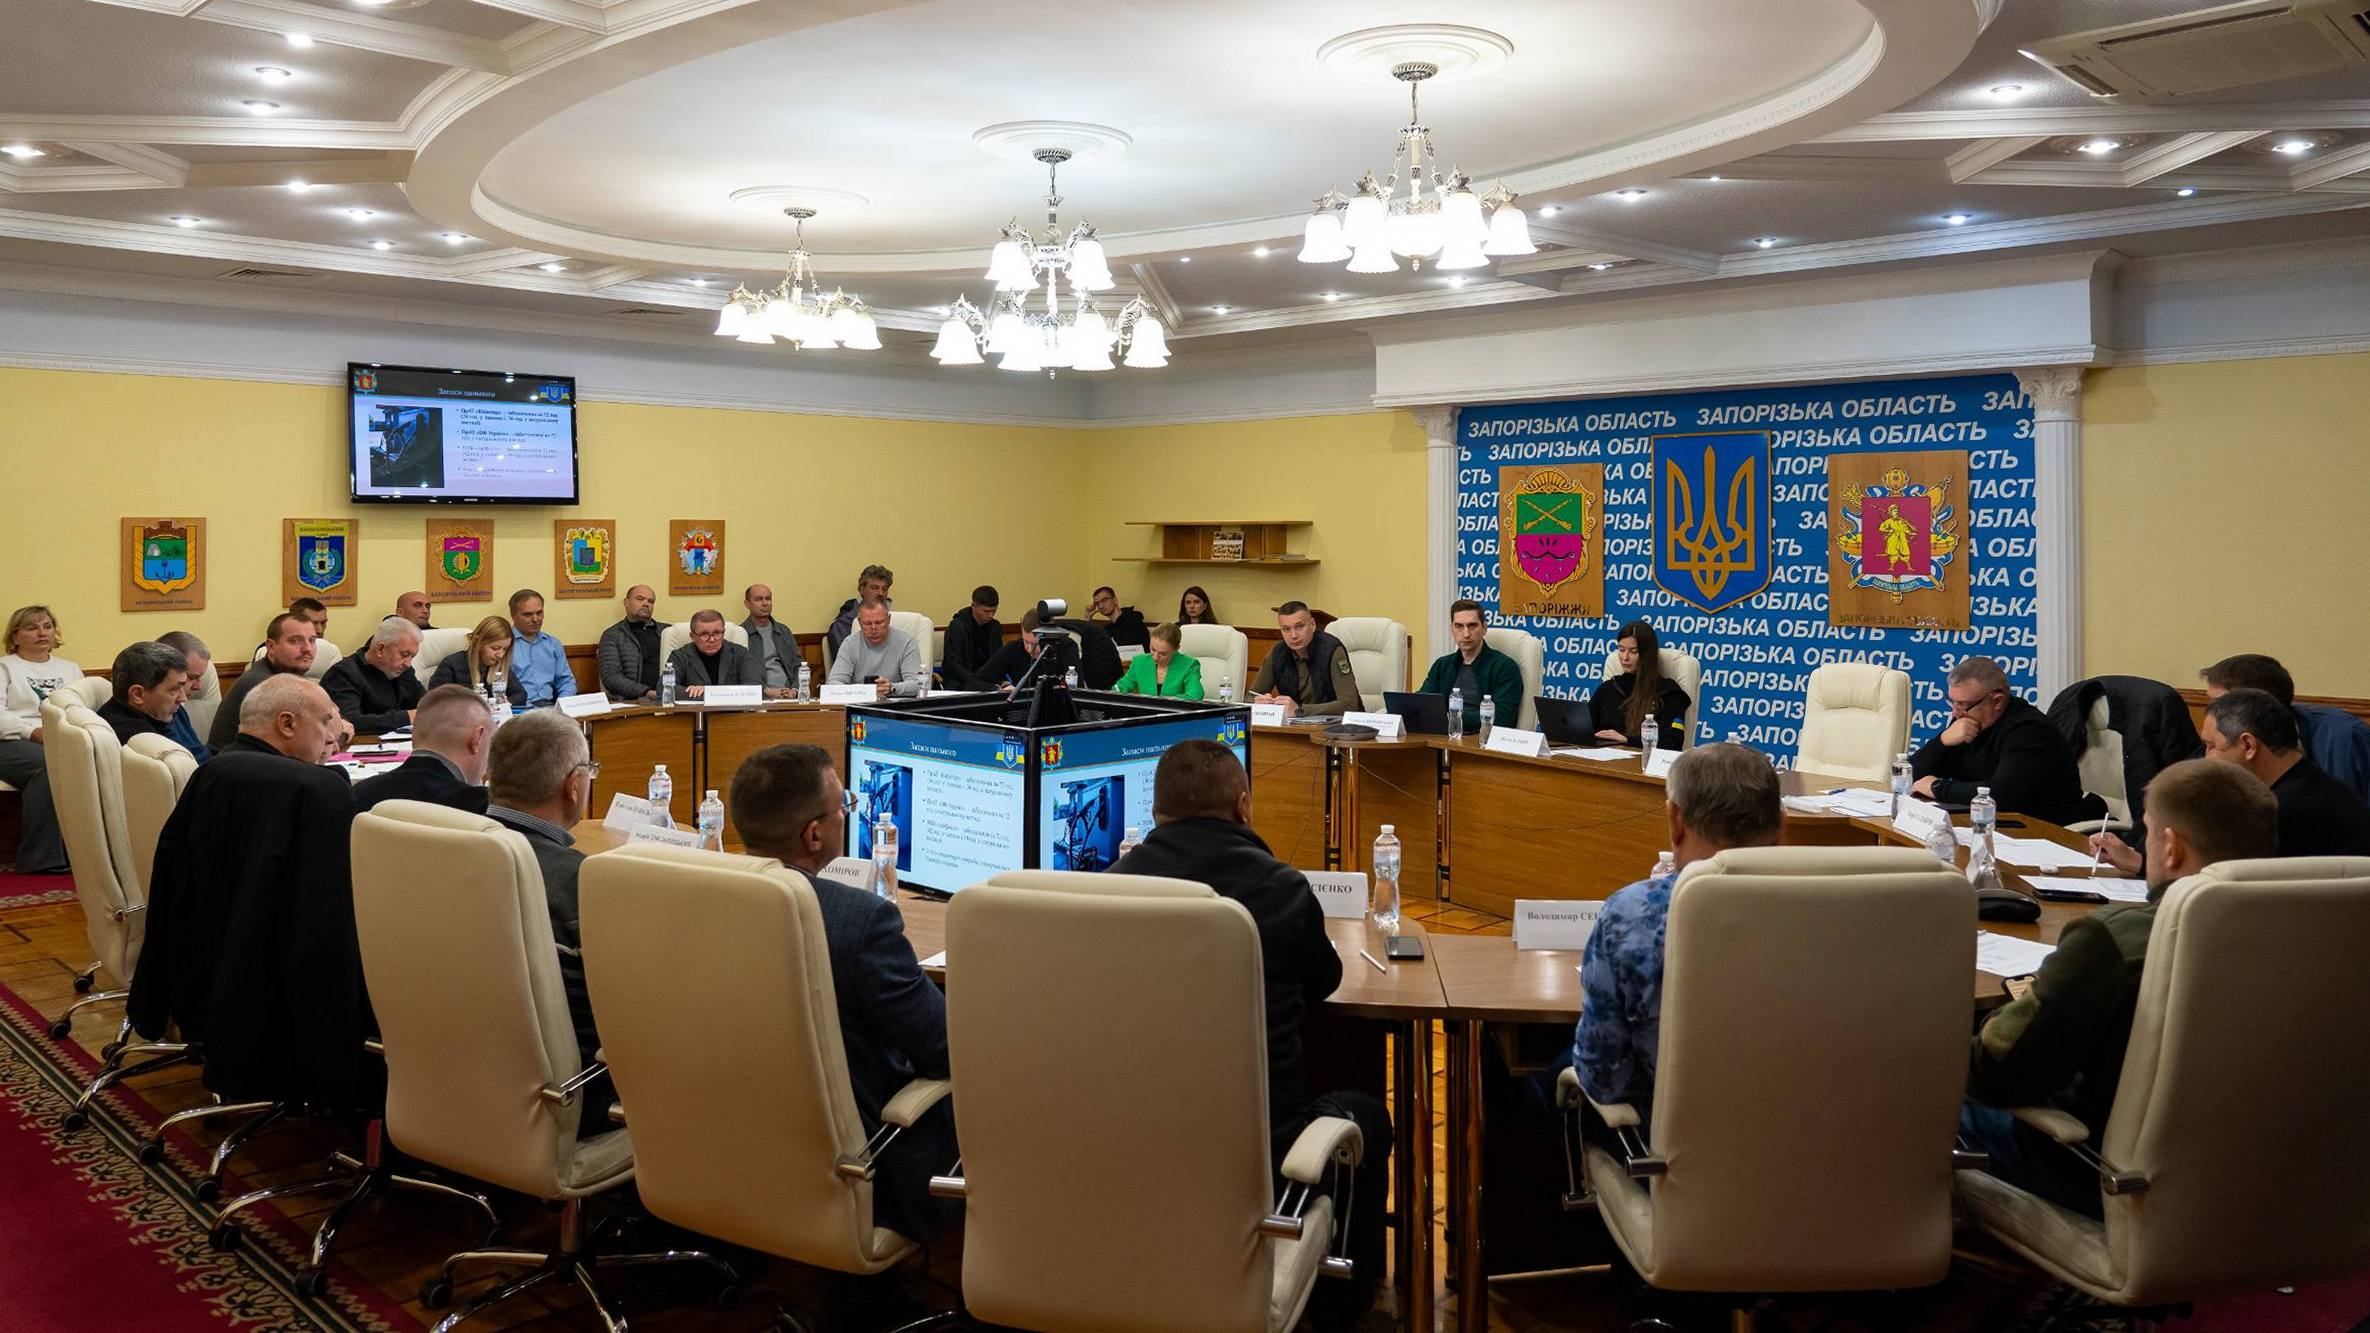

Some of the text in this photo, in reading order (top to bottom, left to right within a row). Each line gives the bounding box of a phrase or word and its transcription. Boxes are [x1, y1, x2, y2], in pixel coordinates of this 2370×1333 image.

[1468, 415, 1579, 438] ЗАПОРІЗЬКА
[1585, 411, 1677, 432] ОБЛАСТЬ
[1696, 401, 1833, 426] ЗАПОРІЗЬКА
[1841, 395, 1956, 418] ОБЛАСТЬ
[1488, 439, 1601, 461] ЗАПОРІЗЬКА
[1607, 437, 1652, 456] ОБЛ
[1869, 421, 1987, 445] ОБЛАСТЬ
[1771, 457, 1828, 475] ПОРІ
[1968, 479, 2036, 499] ЛАСТ
[1777, 621, 1886, 641] ОБЛАСТЬ
[1737, 724, 1802, 746] ЗАПО
[1527, 911, 1578, 923] Володимир
